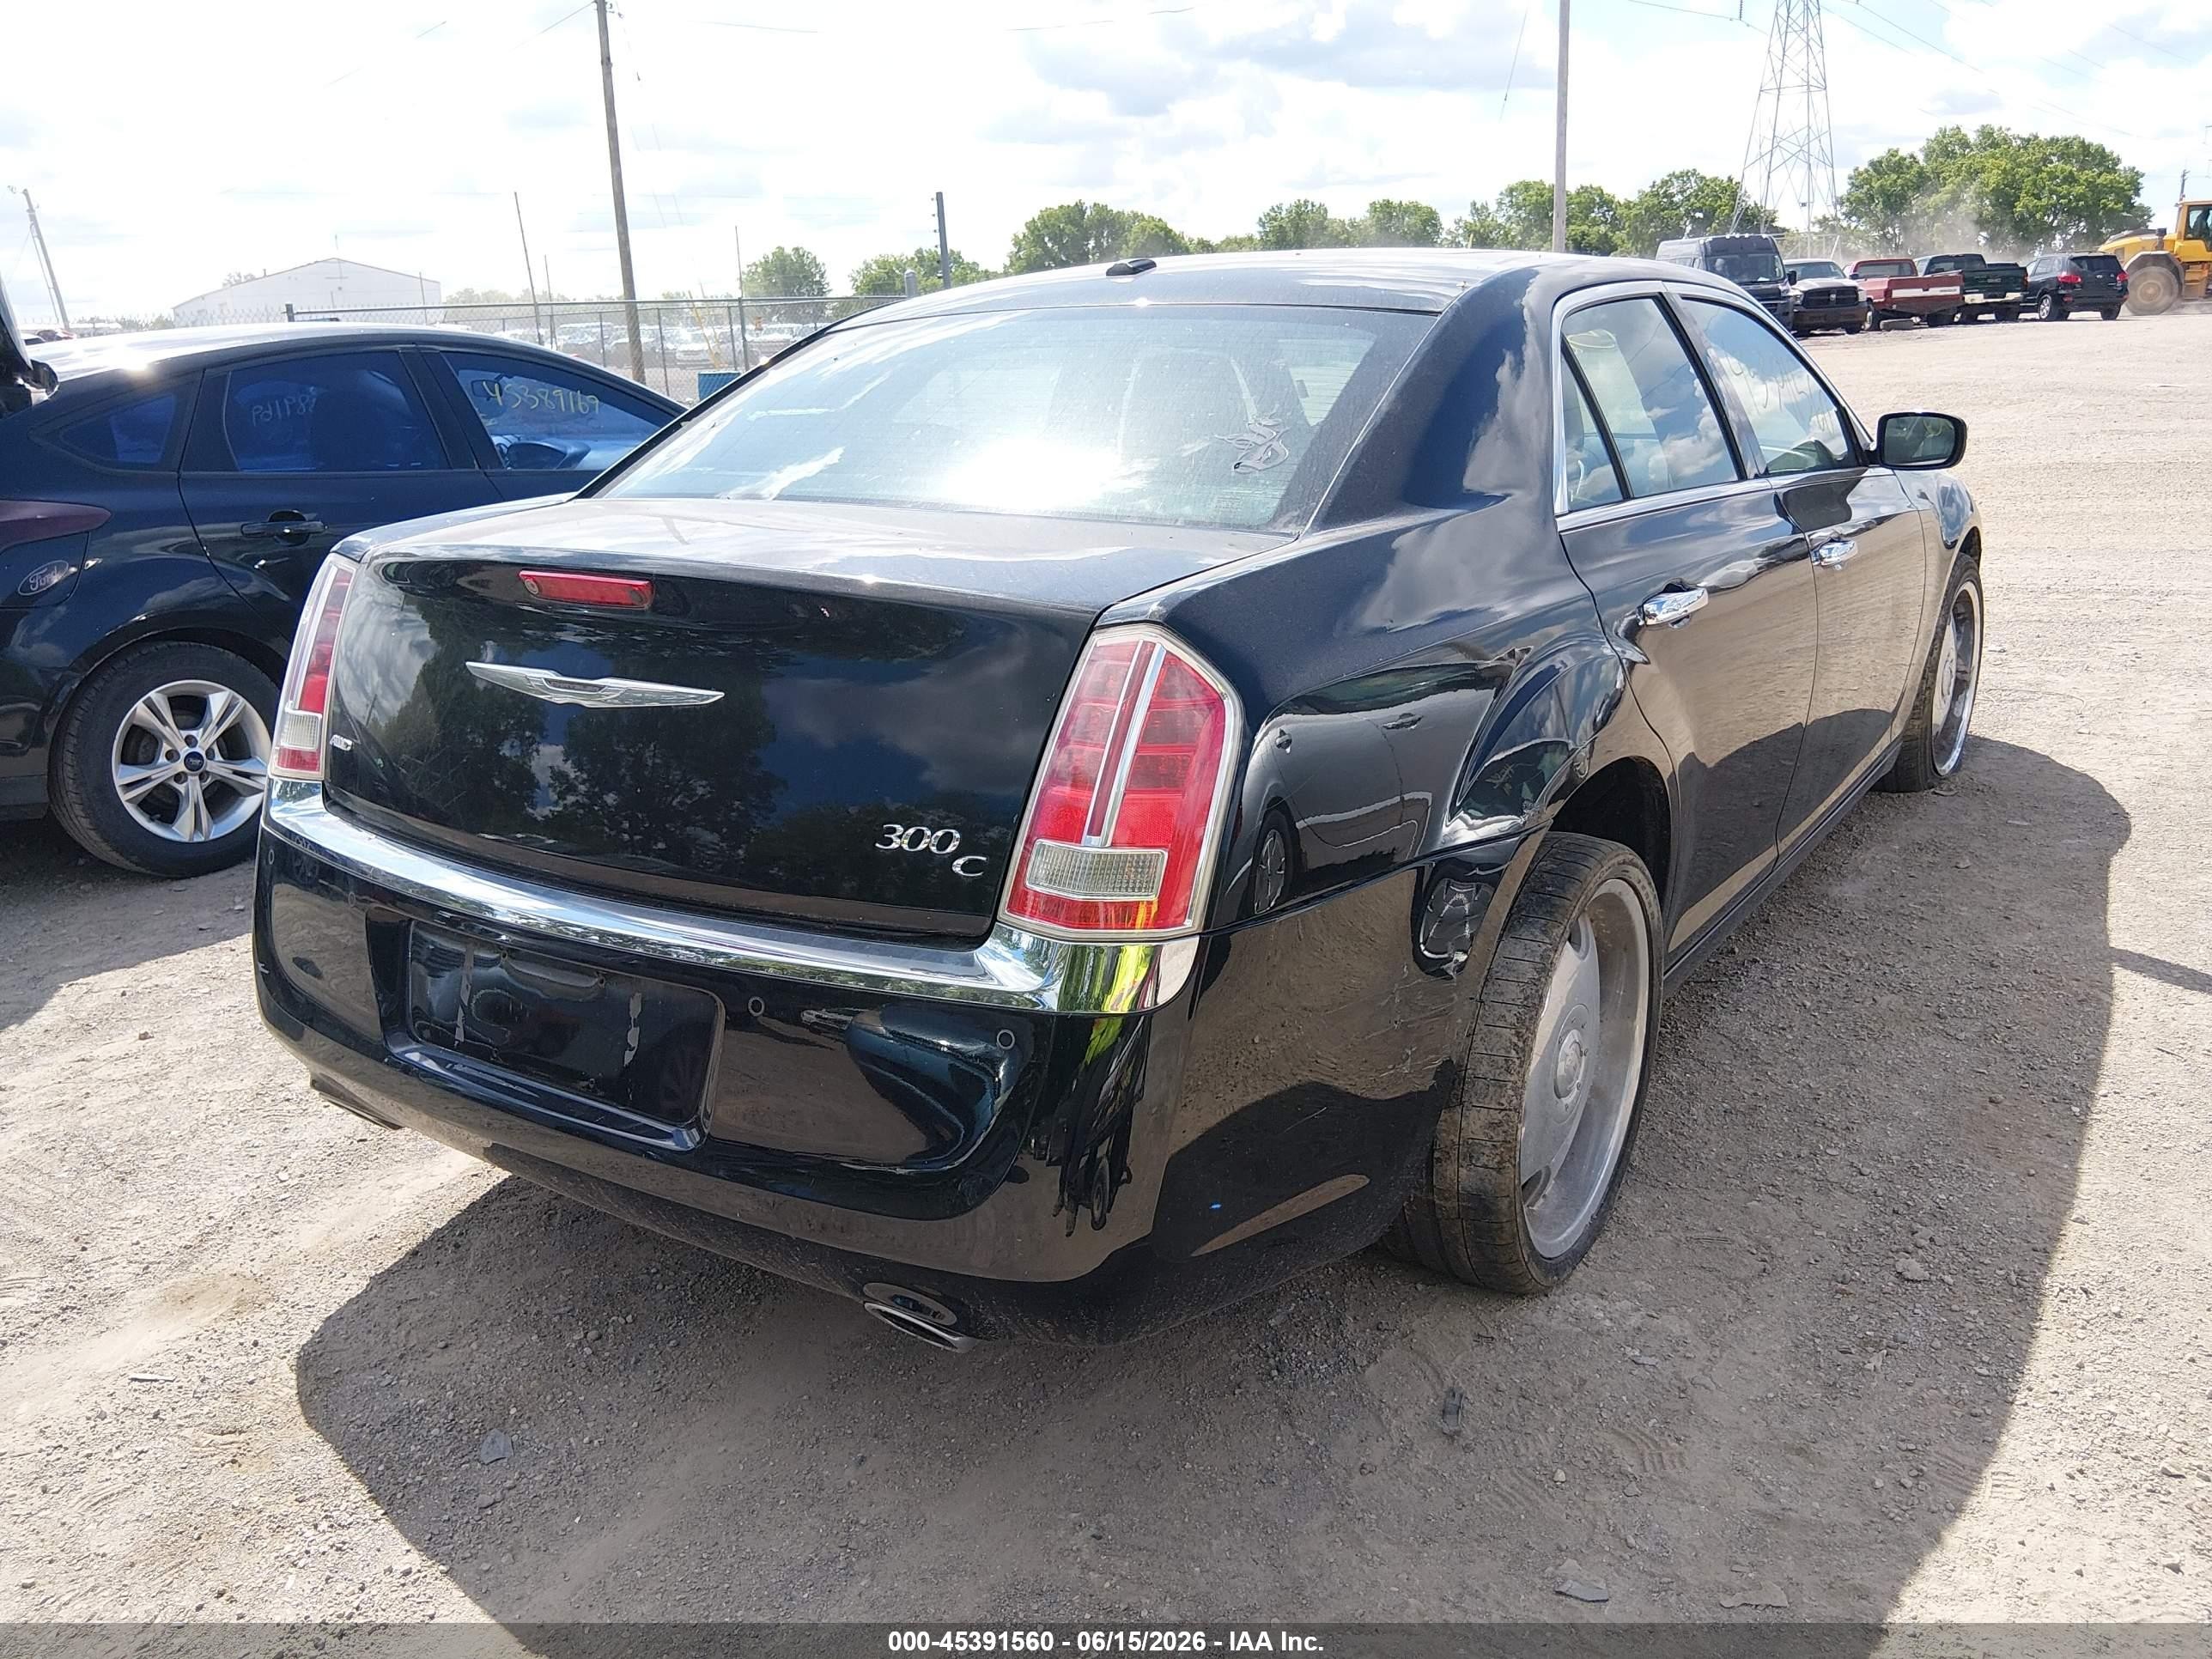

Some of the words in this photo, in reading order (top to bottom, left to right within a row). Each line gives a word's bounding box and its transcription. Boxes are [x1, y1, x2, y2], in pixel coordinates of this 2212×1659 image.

[28, 565, 58, 592] Ford
[874, 823, 961, 855] 300
[951, 854, 988, 878] C
